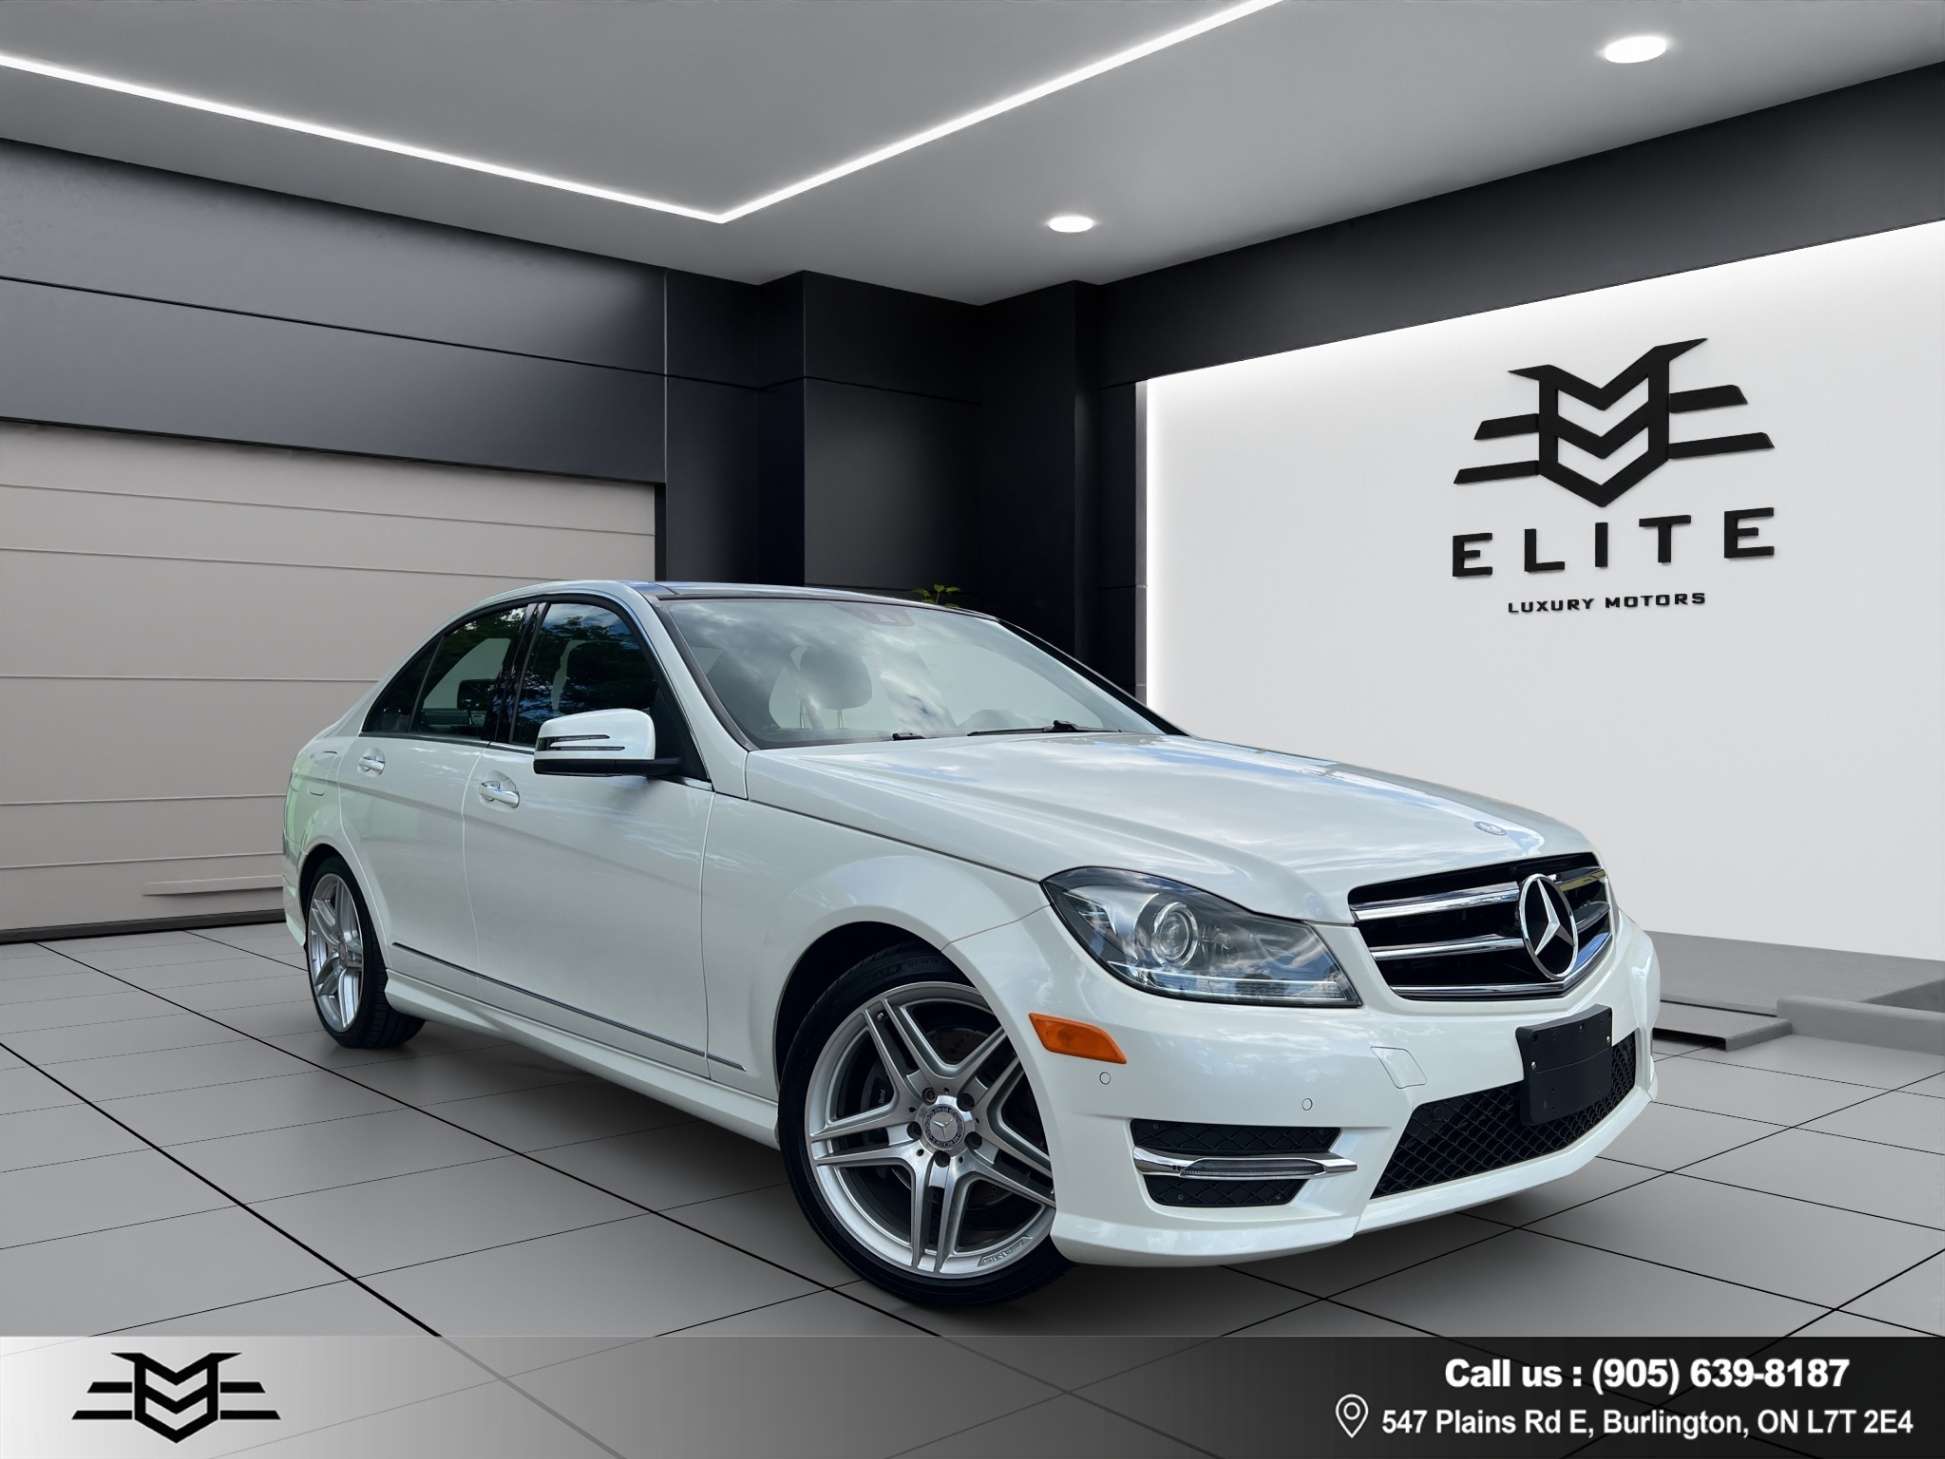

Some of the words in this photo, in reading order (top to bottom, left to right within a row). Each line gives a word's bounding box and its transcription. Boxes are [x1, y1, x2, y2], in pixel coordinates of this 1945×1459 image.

[1452, 506, 1775, 578] ELITE
[1508, 598, 1594, 614] LUXURY
[1605, 592, 1706, 609] MOTORS
